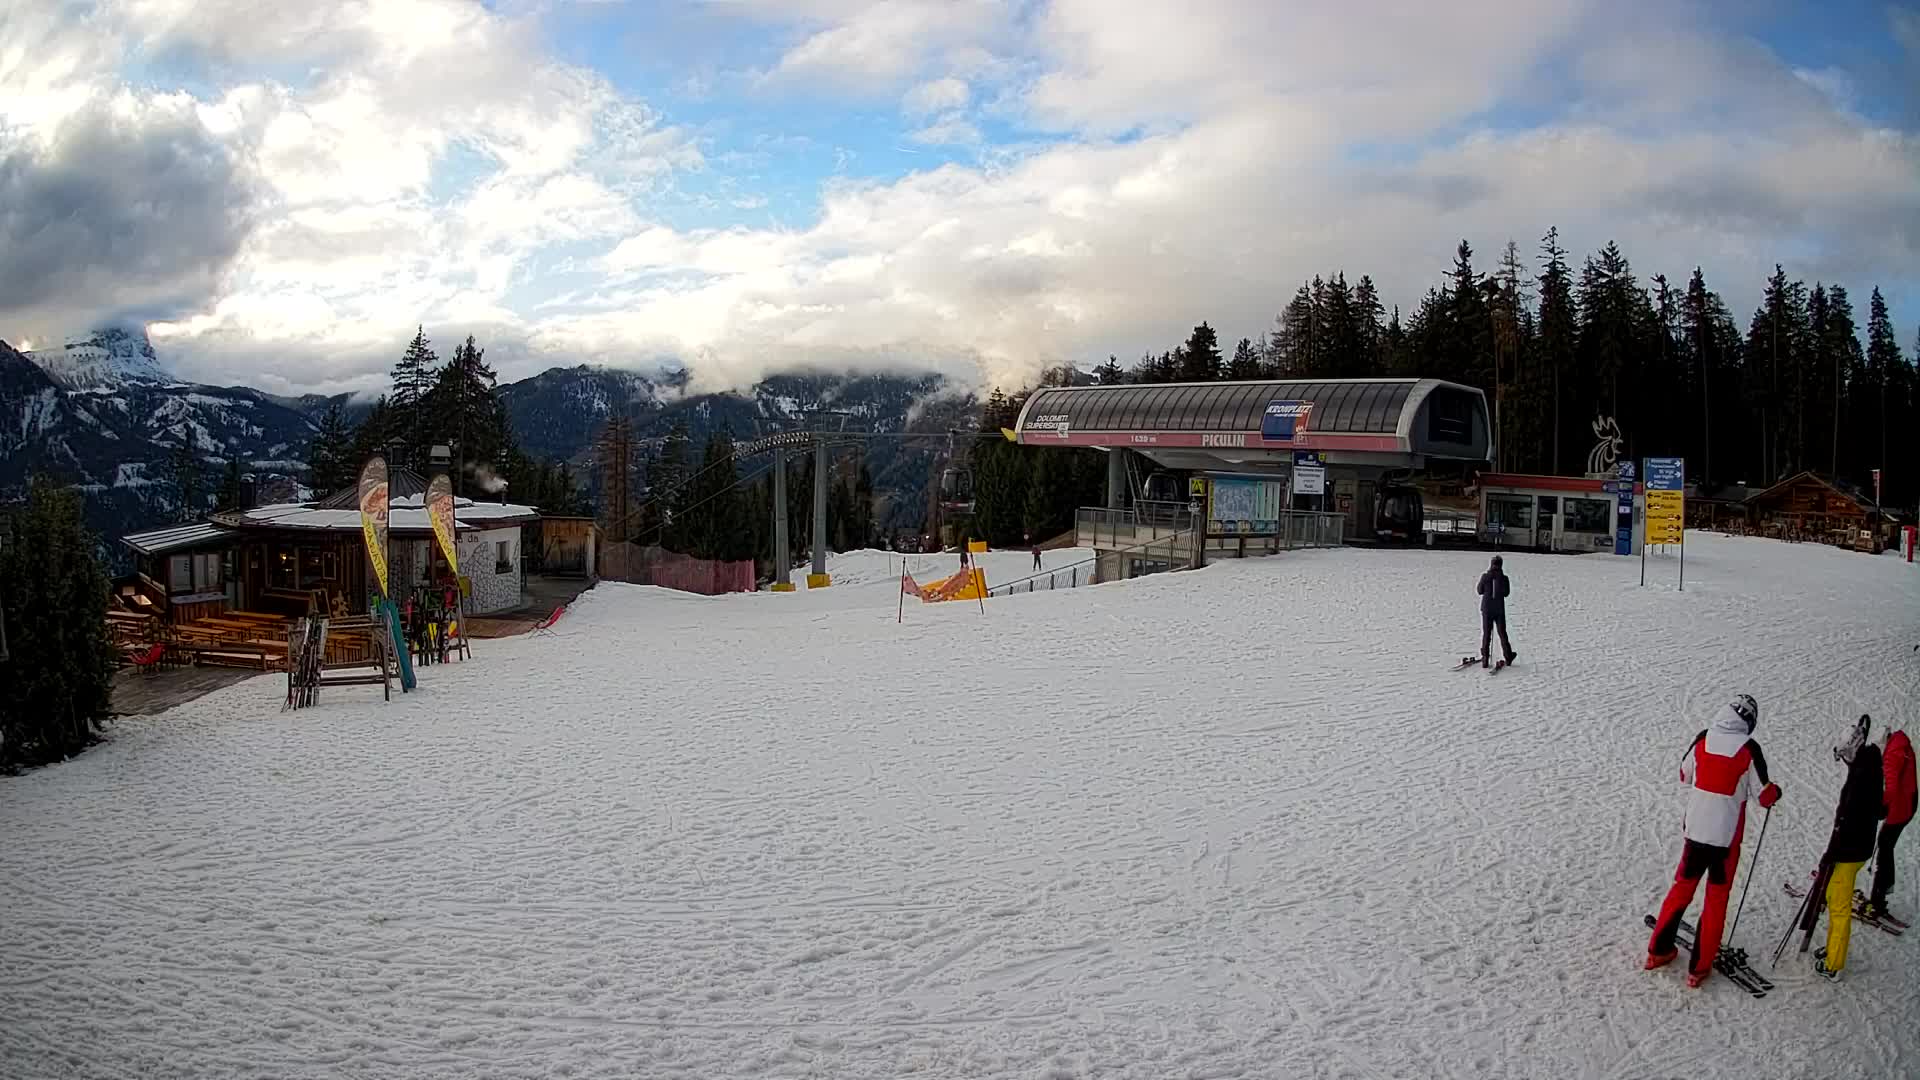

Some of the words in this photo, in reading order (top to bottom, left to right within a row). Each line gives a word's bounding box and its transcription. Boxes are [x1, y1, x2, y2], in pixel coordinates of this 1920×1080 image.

[1266, 405, 1313, 414] KRONPLATZ
[1036, 414, 1069, 422] DOLOMITI
[1202, 434, 1245, 448] PICULIN
